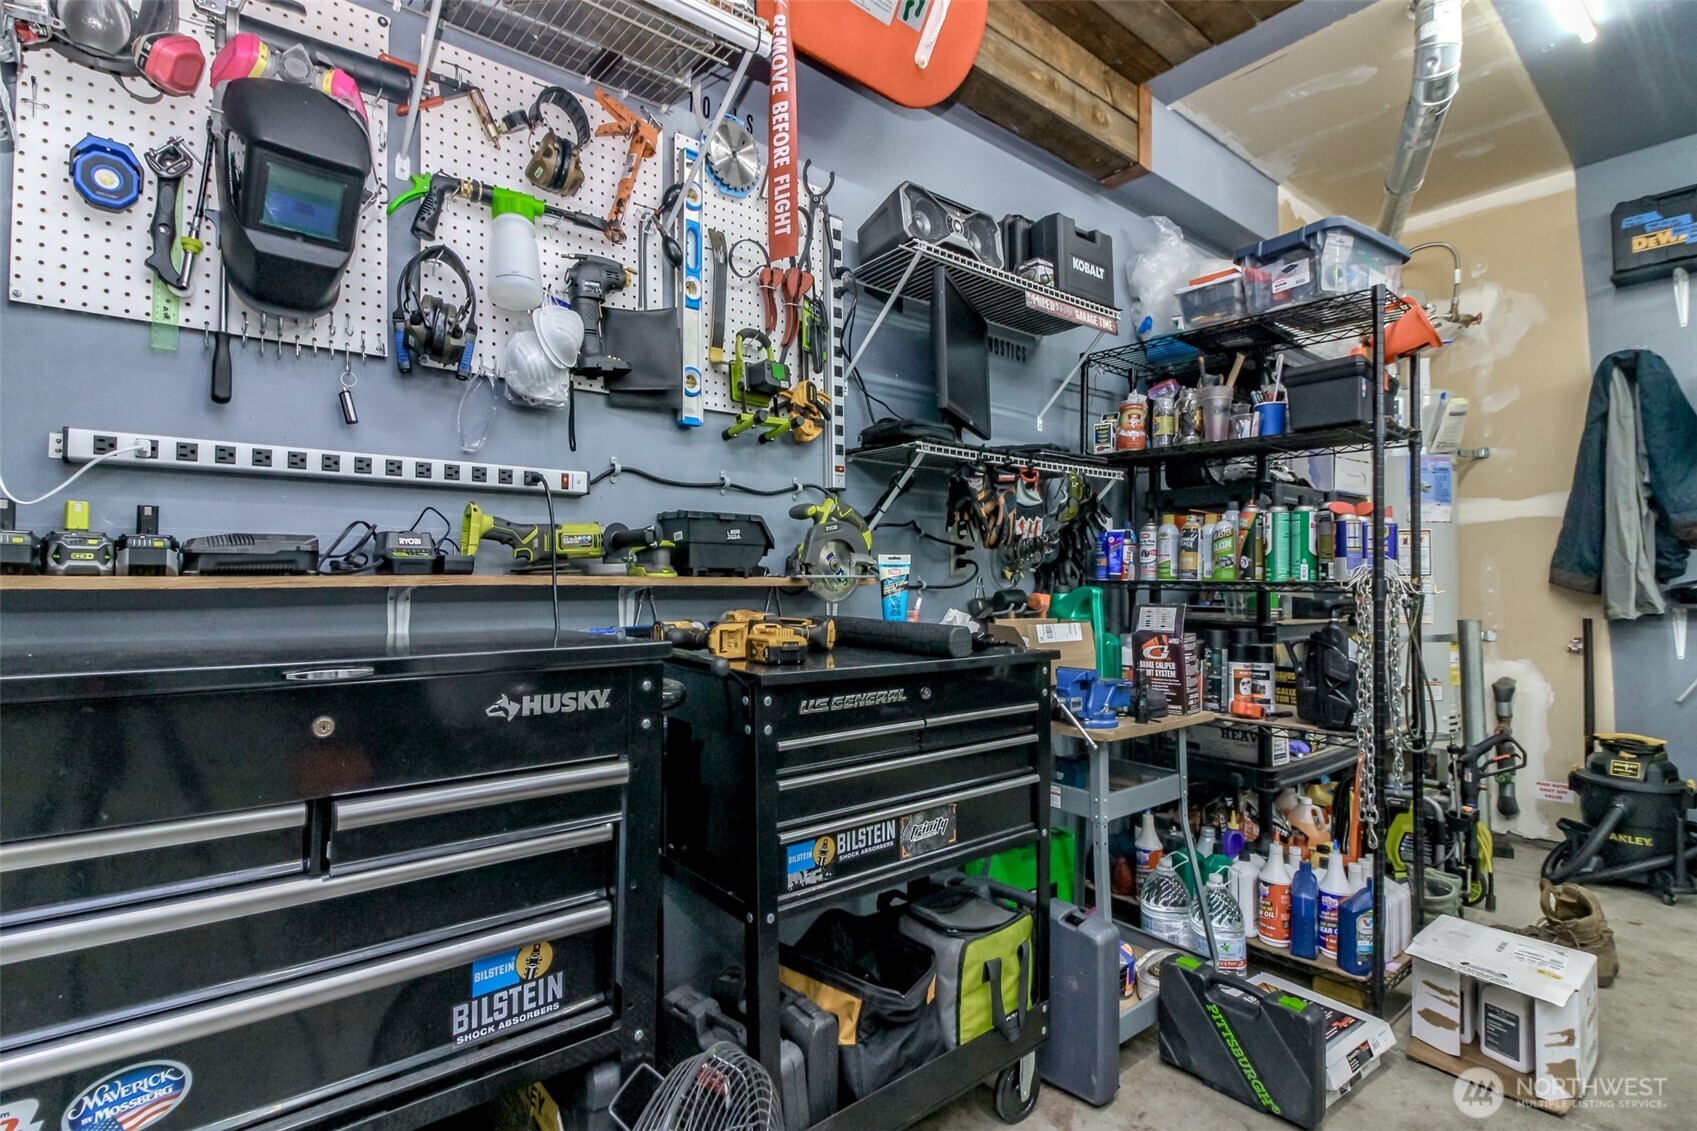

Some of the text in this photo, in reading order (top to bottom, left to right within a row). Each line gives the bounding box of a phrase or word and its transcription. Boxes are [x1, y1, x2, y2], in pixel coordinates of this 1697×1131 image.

[772, 14, 791, 235] REMOVE BEFORE FLIGHT
[1072, 257, 1105, 279] KOBALT
[1074, 309, 1098, 326] GARAGE
[1099, 317, 1113, 332] TIME
[398, 537, 422, 545] RYOBI
[1155, 661, 1176, 670] CALIPER
[1155, 669, 1177, 678] SYSTEM
[522, 688, 611, 716] HUSKY
[830, 688, 908, 711] GENERAL
[837, 820, 896, 855] BILSTEIN
[788, 847, 813, 864] BILSTEIN
[839, 840, 895, 862] SHOCK ABSORBERS
[1263, 911, 1276, 919] OIL
[474, 961, 515, 983] BILSTEIN
[452, 970, 563, 1036] BILSTEIN
[456, 1002, 560, 1045] SHOCK ABSORBERS
[67, 1067, 187, 1120] MAVERICK
[81, 1083, 175, 1125] BY MOSSBERG
